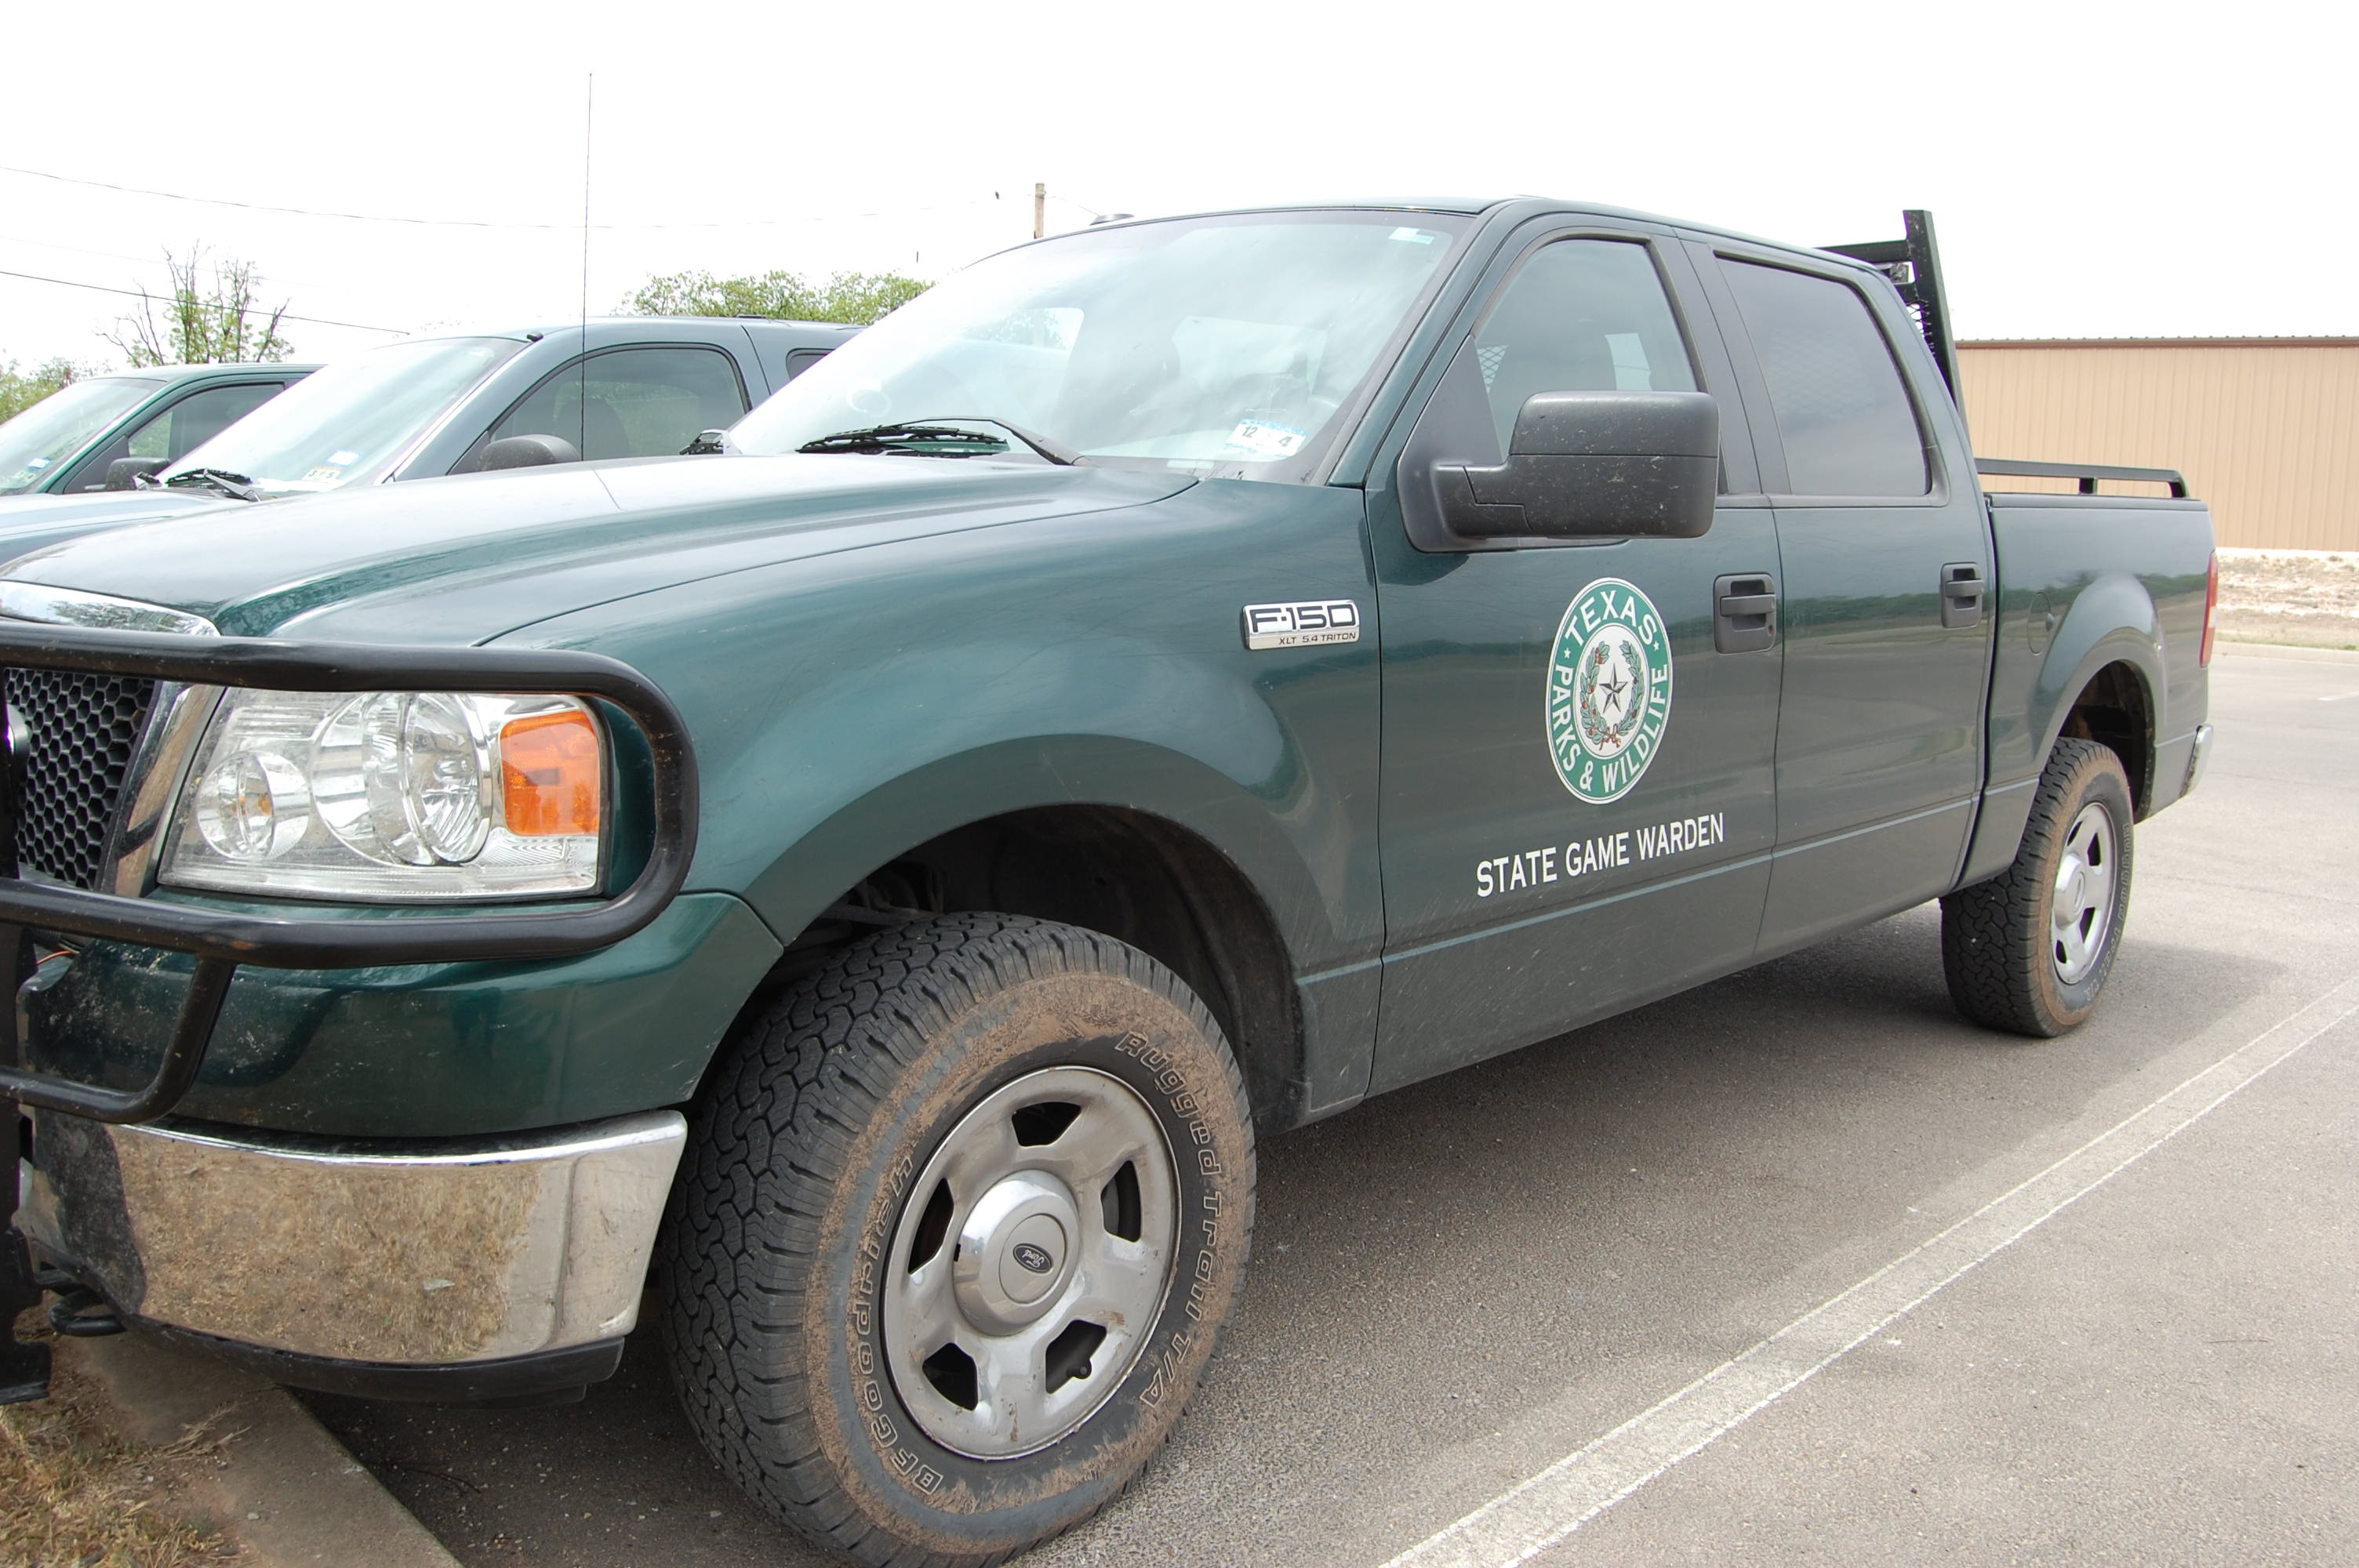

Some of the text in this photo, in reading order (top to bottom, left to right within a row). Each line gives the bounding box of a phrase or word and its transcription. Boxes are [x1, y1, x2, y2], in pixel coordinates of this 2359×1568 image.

[1321, 632, 1357, 641] TRITON
[1565, 590, 1657, 647] TEXAS
[1555, 663, 1668, 793] PARKS & WILDLIFE
[1477, 811, 1725, 898] STATE GAME WARDEN
[1114, 1030, 1222, 1177] Rugged
[1185, 1190, 1223, 1321] Trail
[1022, 1249, 1045, 1268] Ford
[852, 1154, 944, 1494] BFGoodrich
